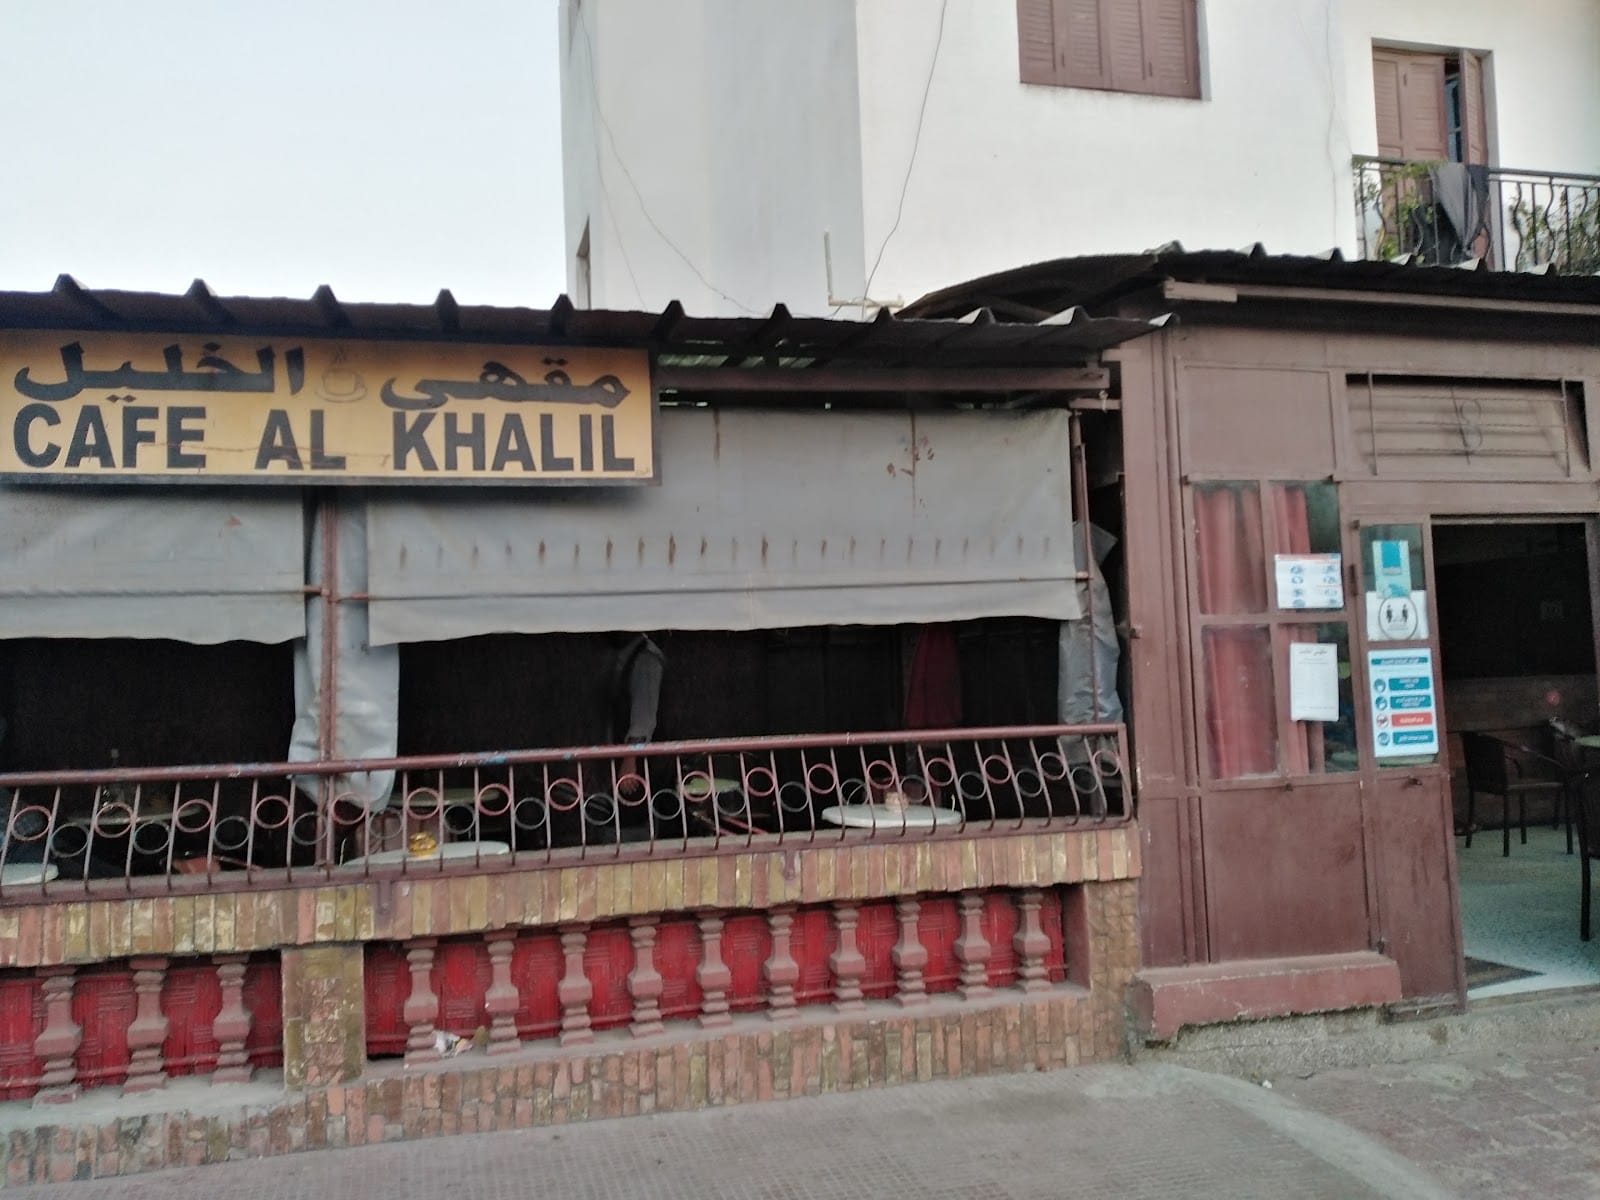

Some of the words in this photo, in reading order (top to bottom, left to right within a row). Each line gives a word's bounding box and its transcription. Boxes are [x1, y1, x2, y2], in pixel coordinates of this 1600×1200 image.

[14, 341, 305, 402] الخليل
[380, 357, 632, 410] مقهى
[13, 403, 207, 468] CAFE
[254, 409, 346, 470] AL
[393, 411, 635, 472] KHALIL
